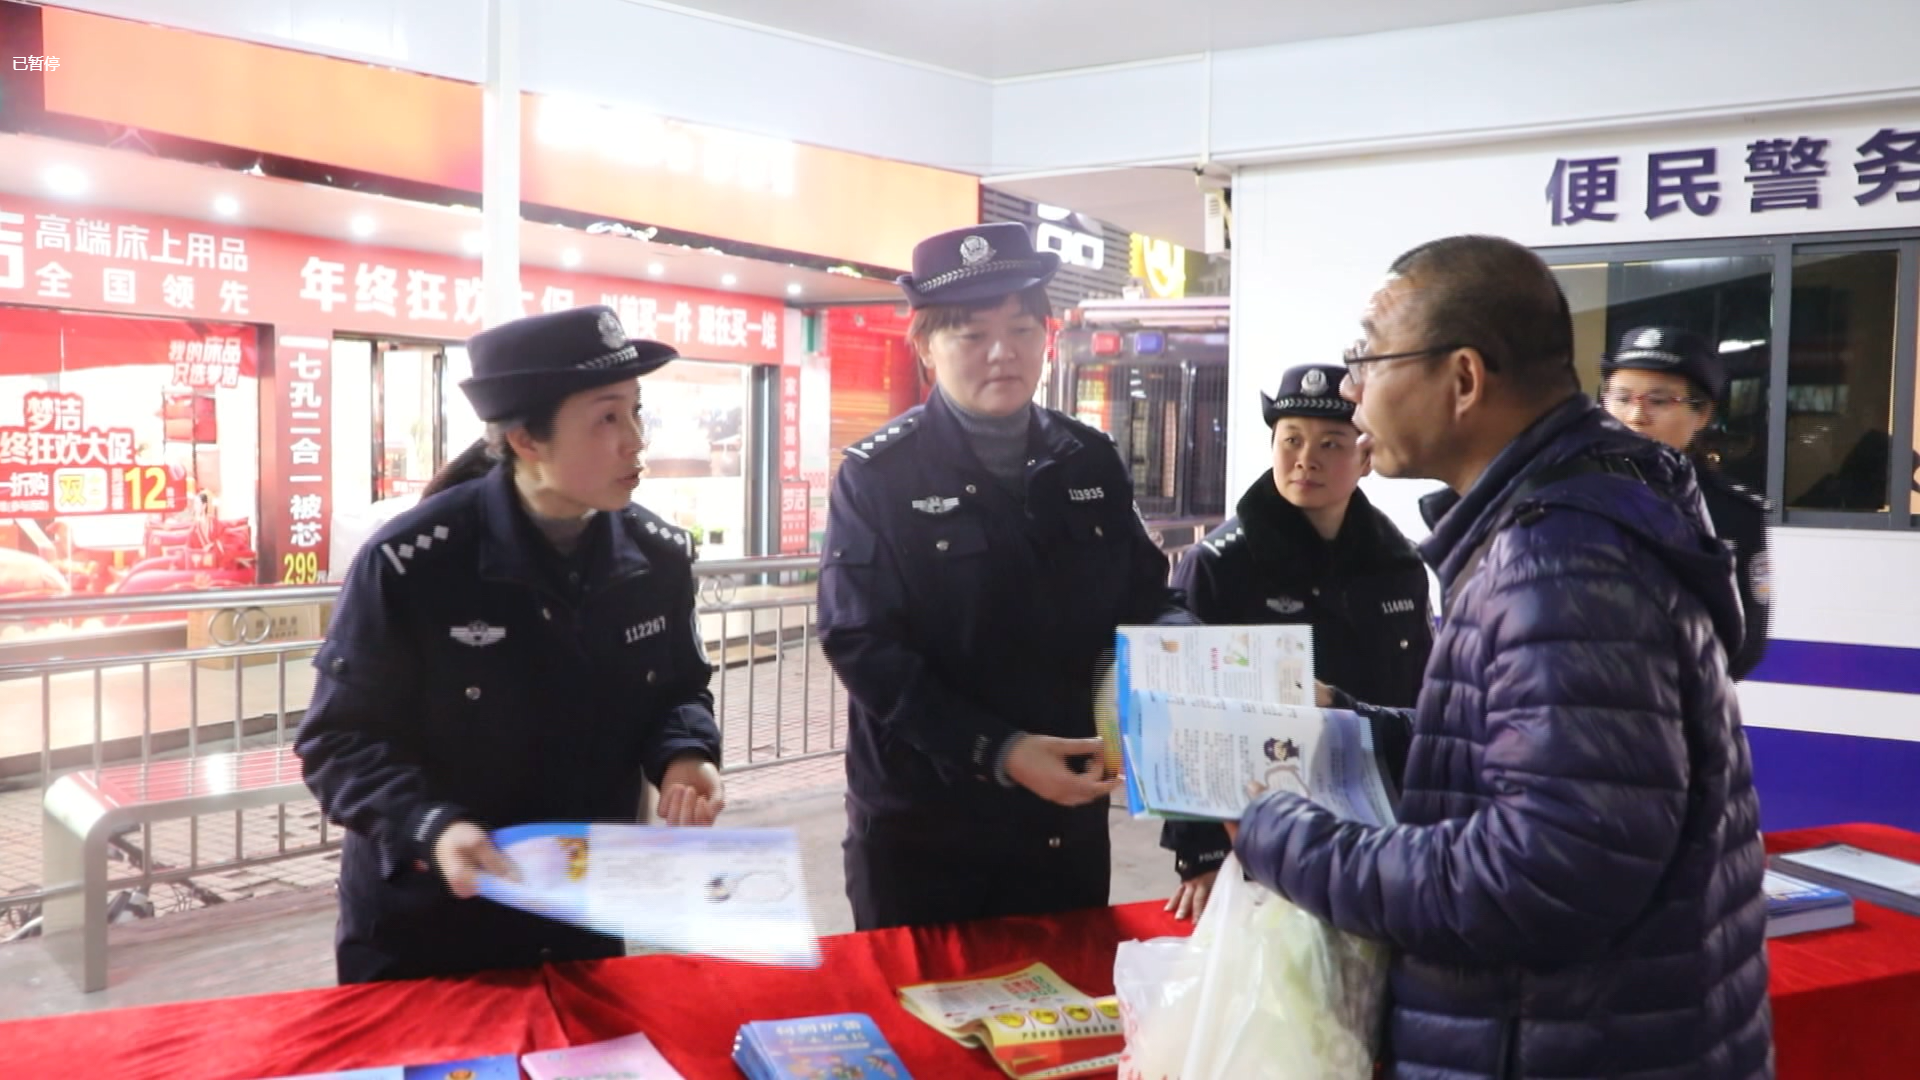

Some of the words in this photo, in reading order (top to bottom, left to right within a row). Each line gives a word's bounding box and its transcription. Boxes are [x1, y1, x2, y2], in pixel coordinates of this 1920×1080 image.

[1545, 128, 1920, 226] 便民警务
[35, 213, 249, 273] 高端床上用品
[35, 260, 250, 316] 全国领先
[26, 396, 82, 430] 梦洁
[125, 467, 167, 510] 12
[624, 615, 666, 644] 112267
